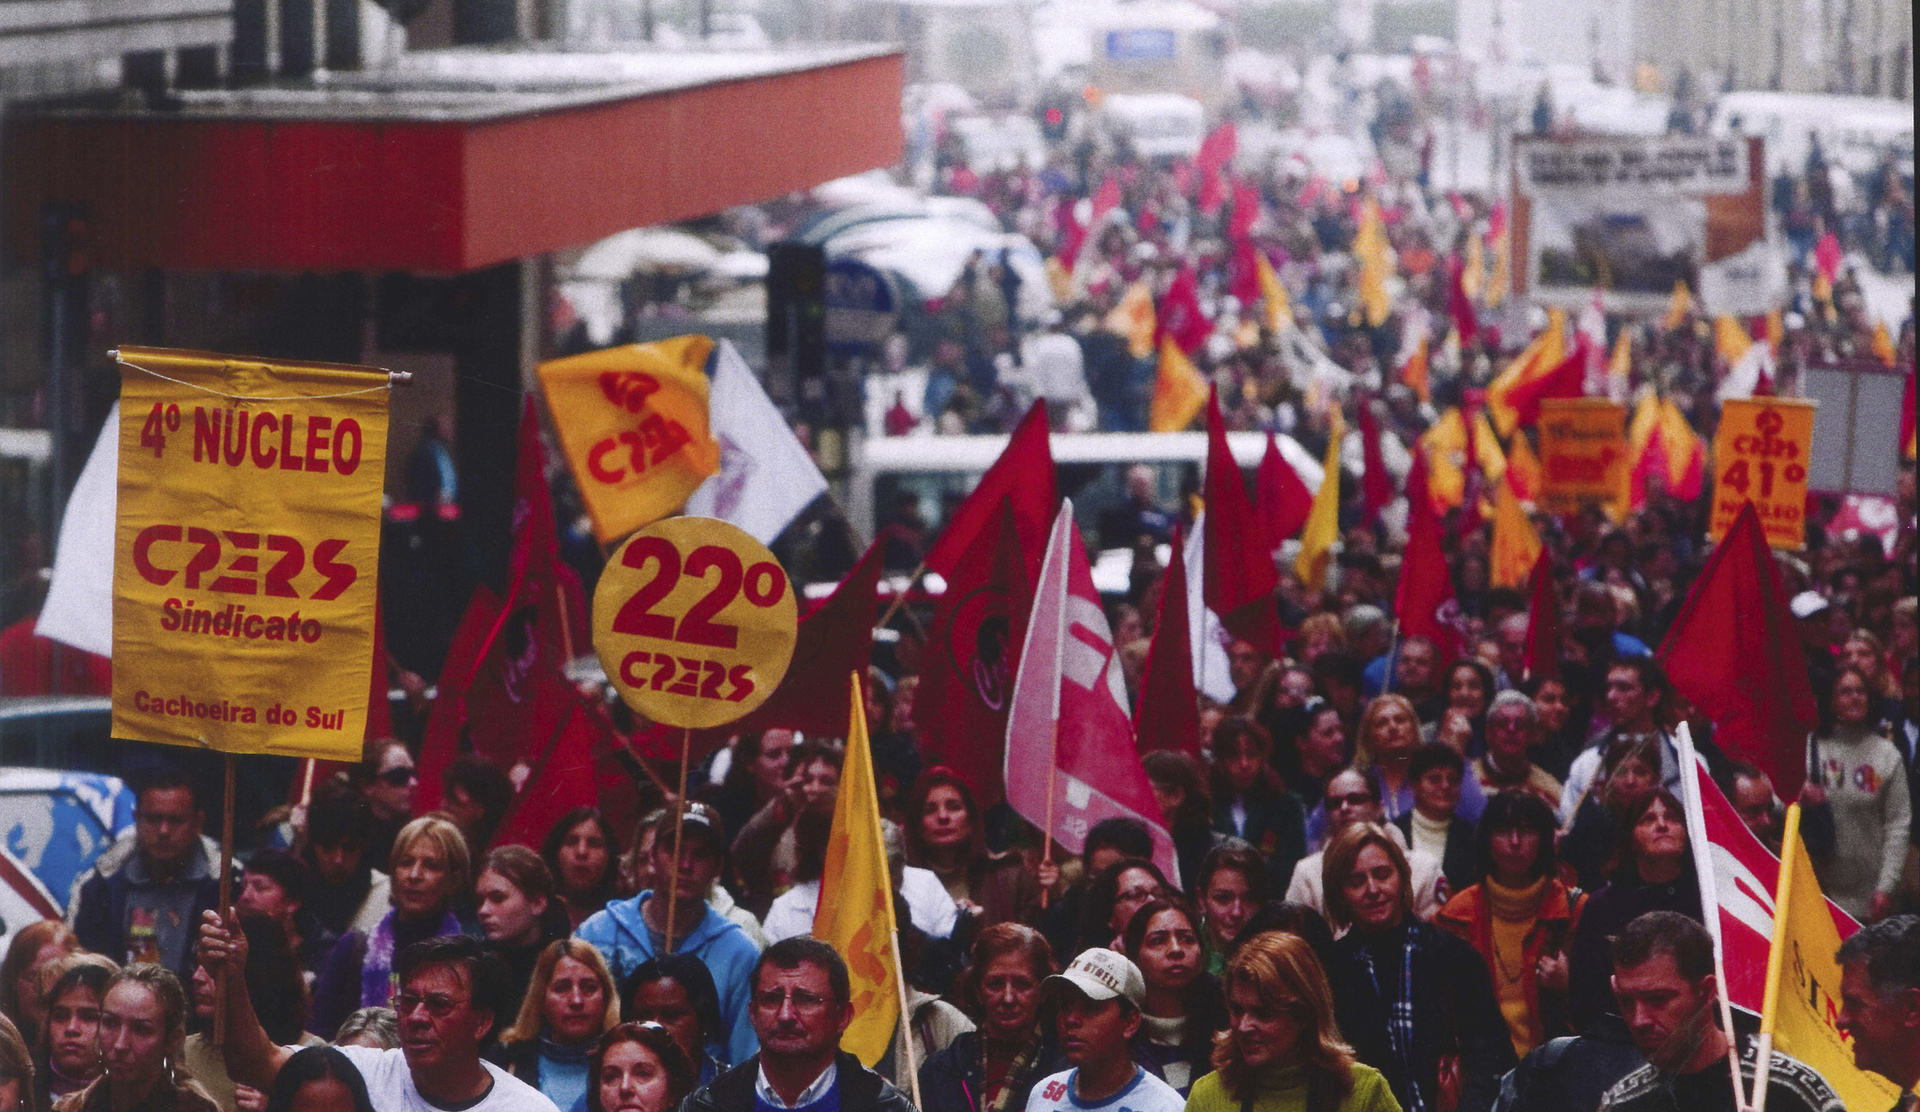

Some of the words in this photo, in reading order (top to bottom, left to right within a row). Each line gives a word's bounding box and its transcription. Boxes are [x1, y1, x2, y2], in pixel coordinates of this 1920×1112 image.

[132, 524, 358, 601] CPERS
[160, 597, 322, 643] Sindicato
[619, 651, 755, 703] CPERS
[133, 690, 257, 724] Cachoeira
[265, 703, 297, 726] do
[305, 706, 344, 731] Sul
[1042, 1080, 1068, 1102] 58
